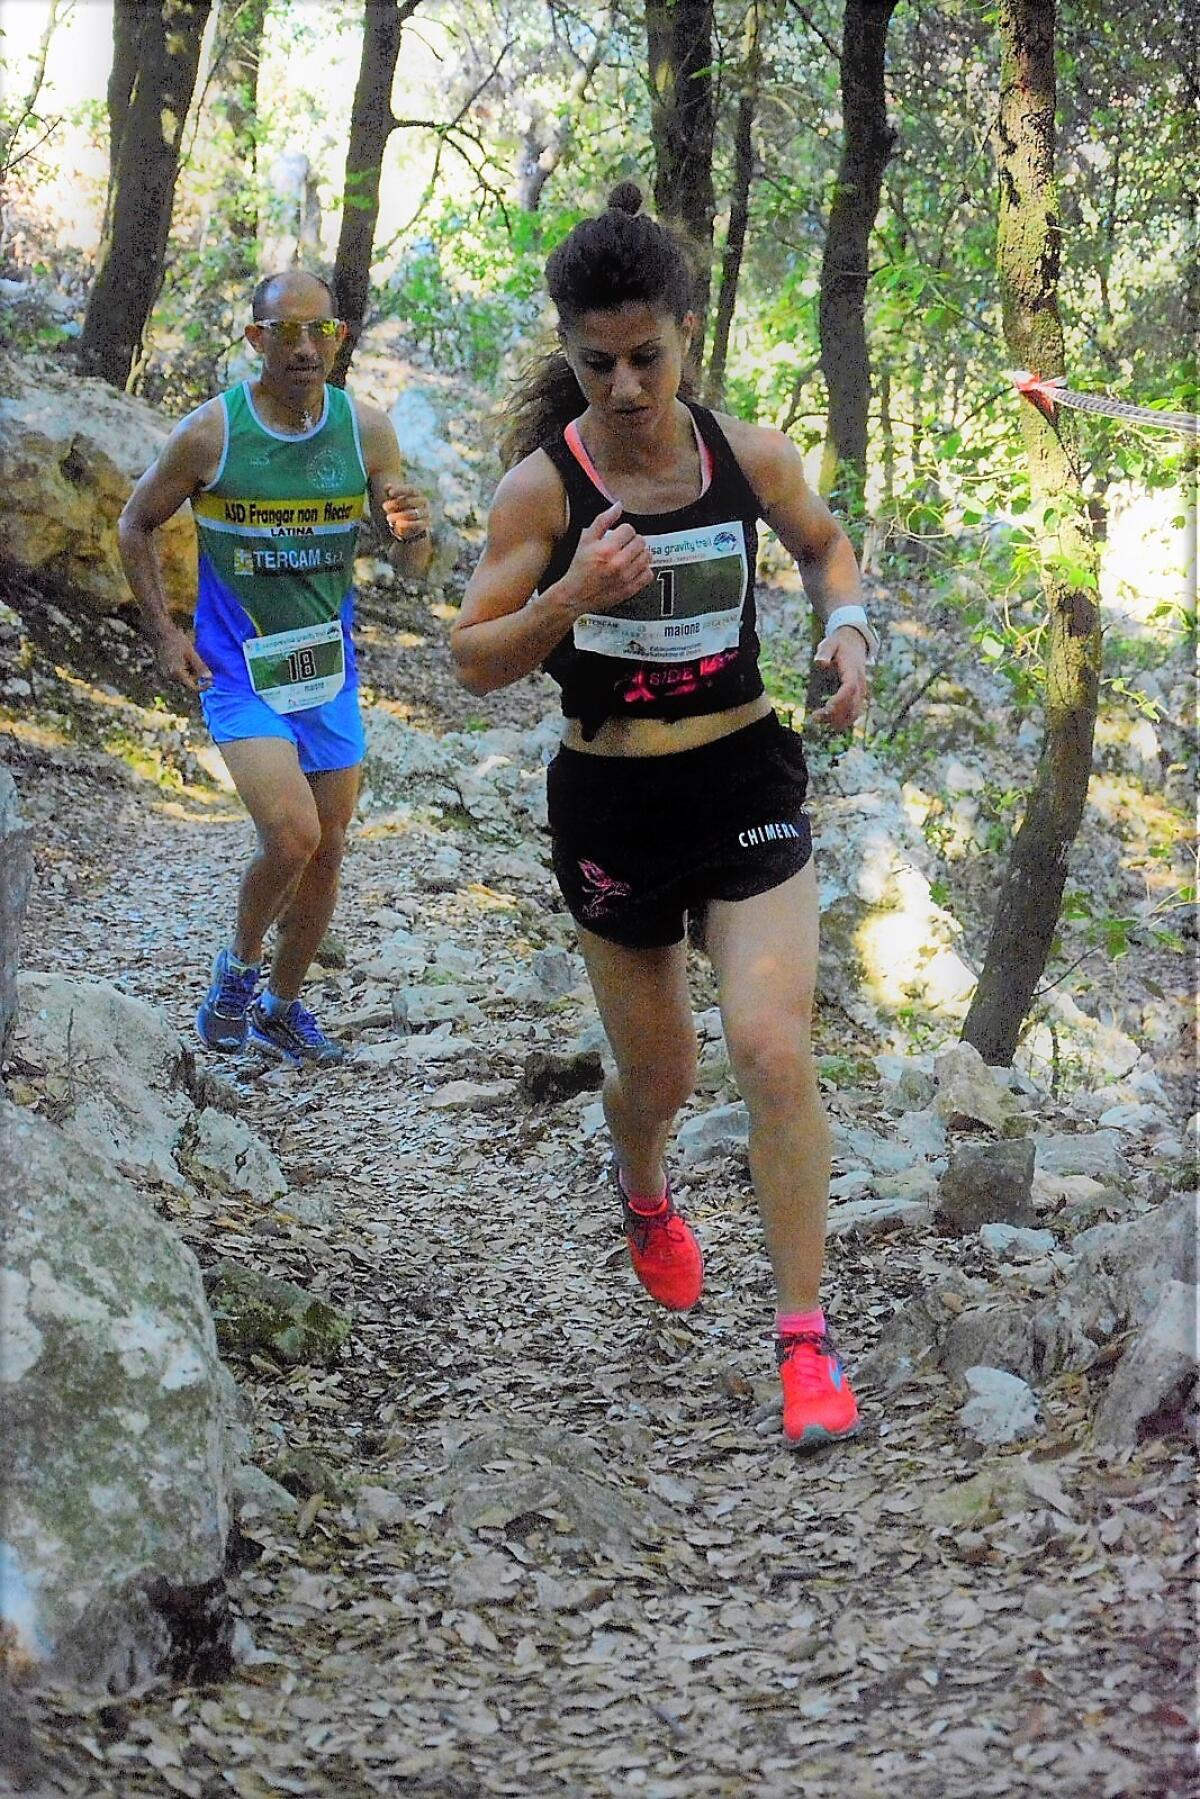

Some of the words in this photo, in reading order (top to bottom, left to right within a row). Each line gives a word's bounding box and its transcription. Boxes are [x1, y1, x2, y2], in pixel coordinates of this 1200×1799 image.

[249, 504, 295, 527] Frangar
[298, 508, 318, 522] non
[271, 527, 315, 536] LATINA
[253, 548, 321, 569] TERCAM
[656, 569, 675, 617] 1
[664, 622, 701, 638] maione
[287, 648, 317, 682] 18
